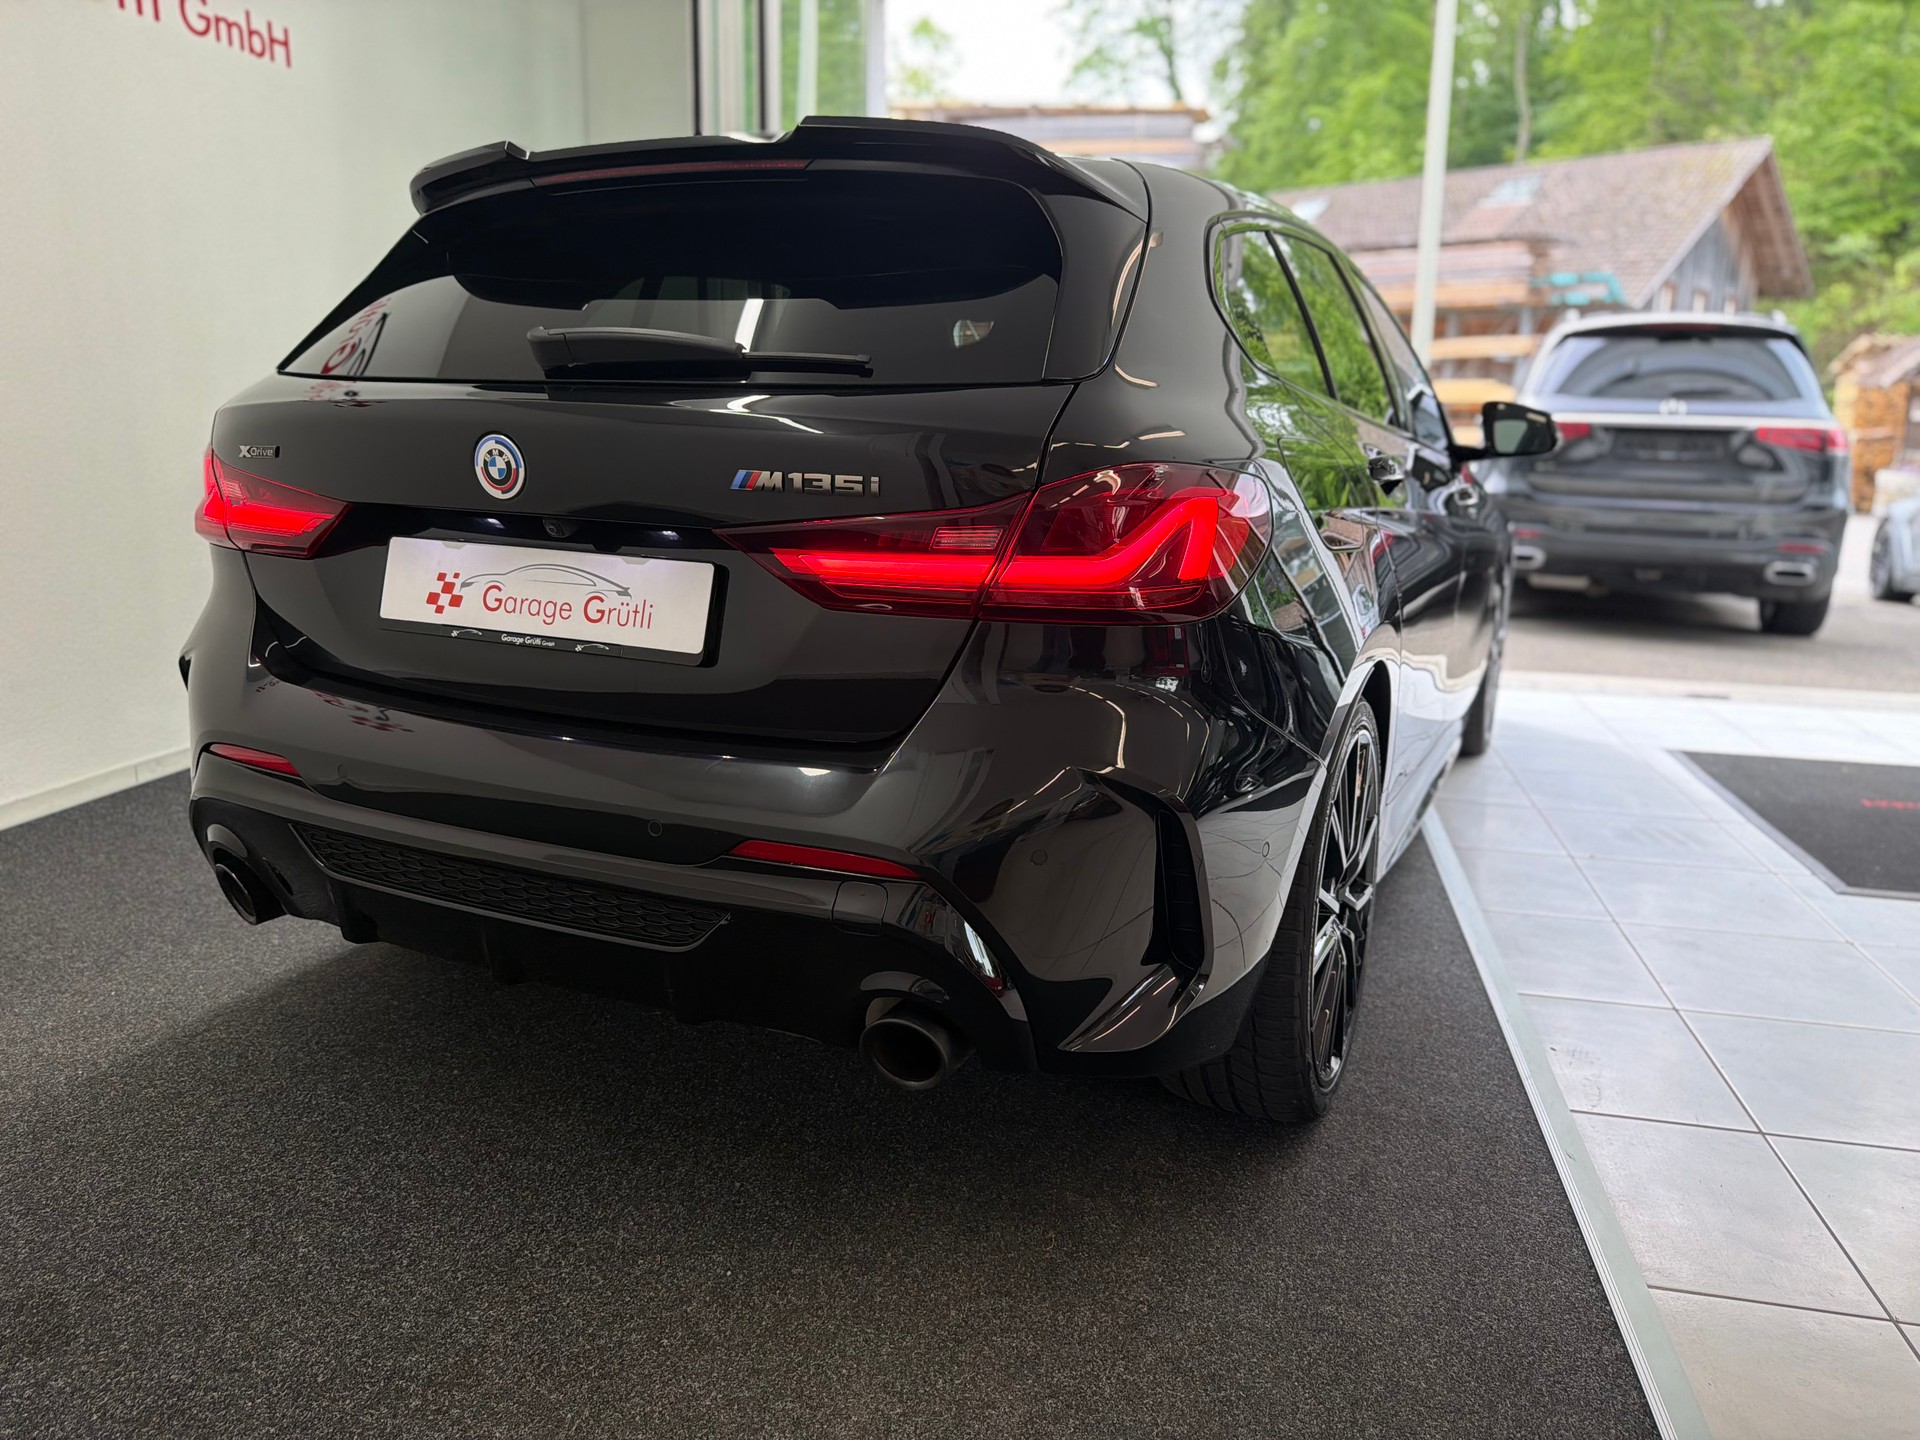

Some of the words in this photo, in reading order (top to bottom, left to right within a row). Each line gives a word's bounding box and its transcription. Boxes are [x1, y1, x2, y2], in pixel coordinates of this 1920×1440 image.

[179, 0, 291, 68] GmbH
[484, 448, 510, 462] BMW
[482, 584, 573, 626] Garage
[583, 595, 653, 629] Grütli
[501, 633, 525, 645] Garage
[525, 636, 542, 646] Grütli
